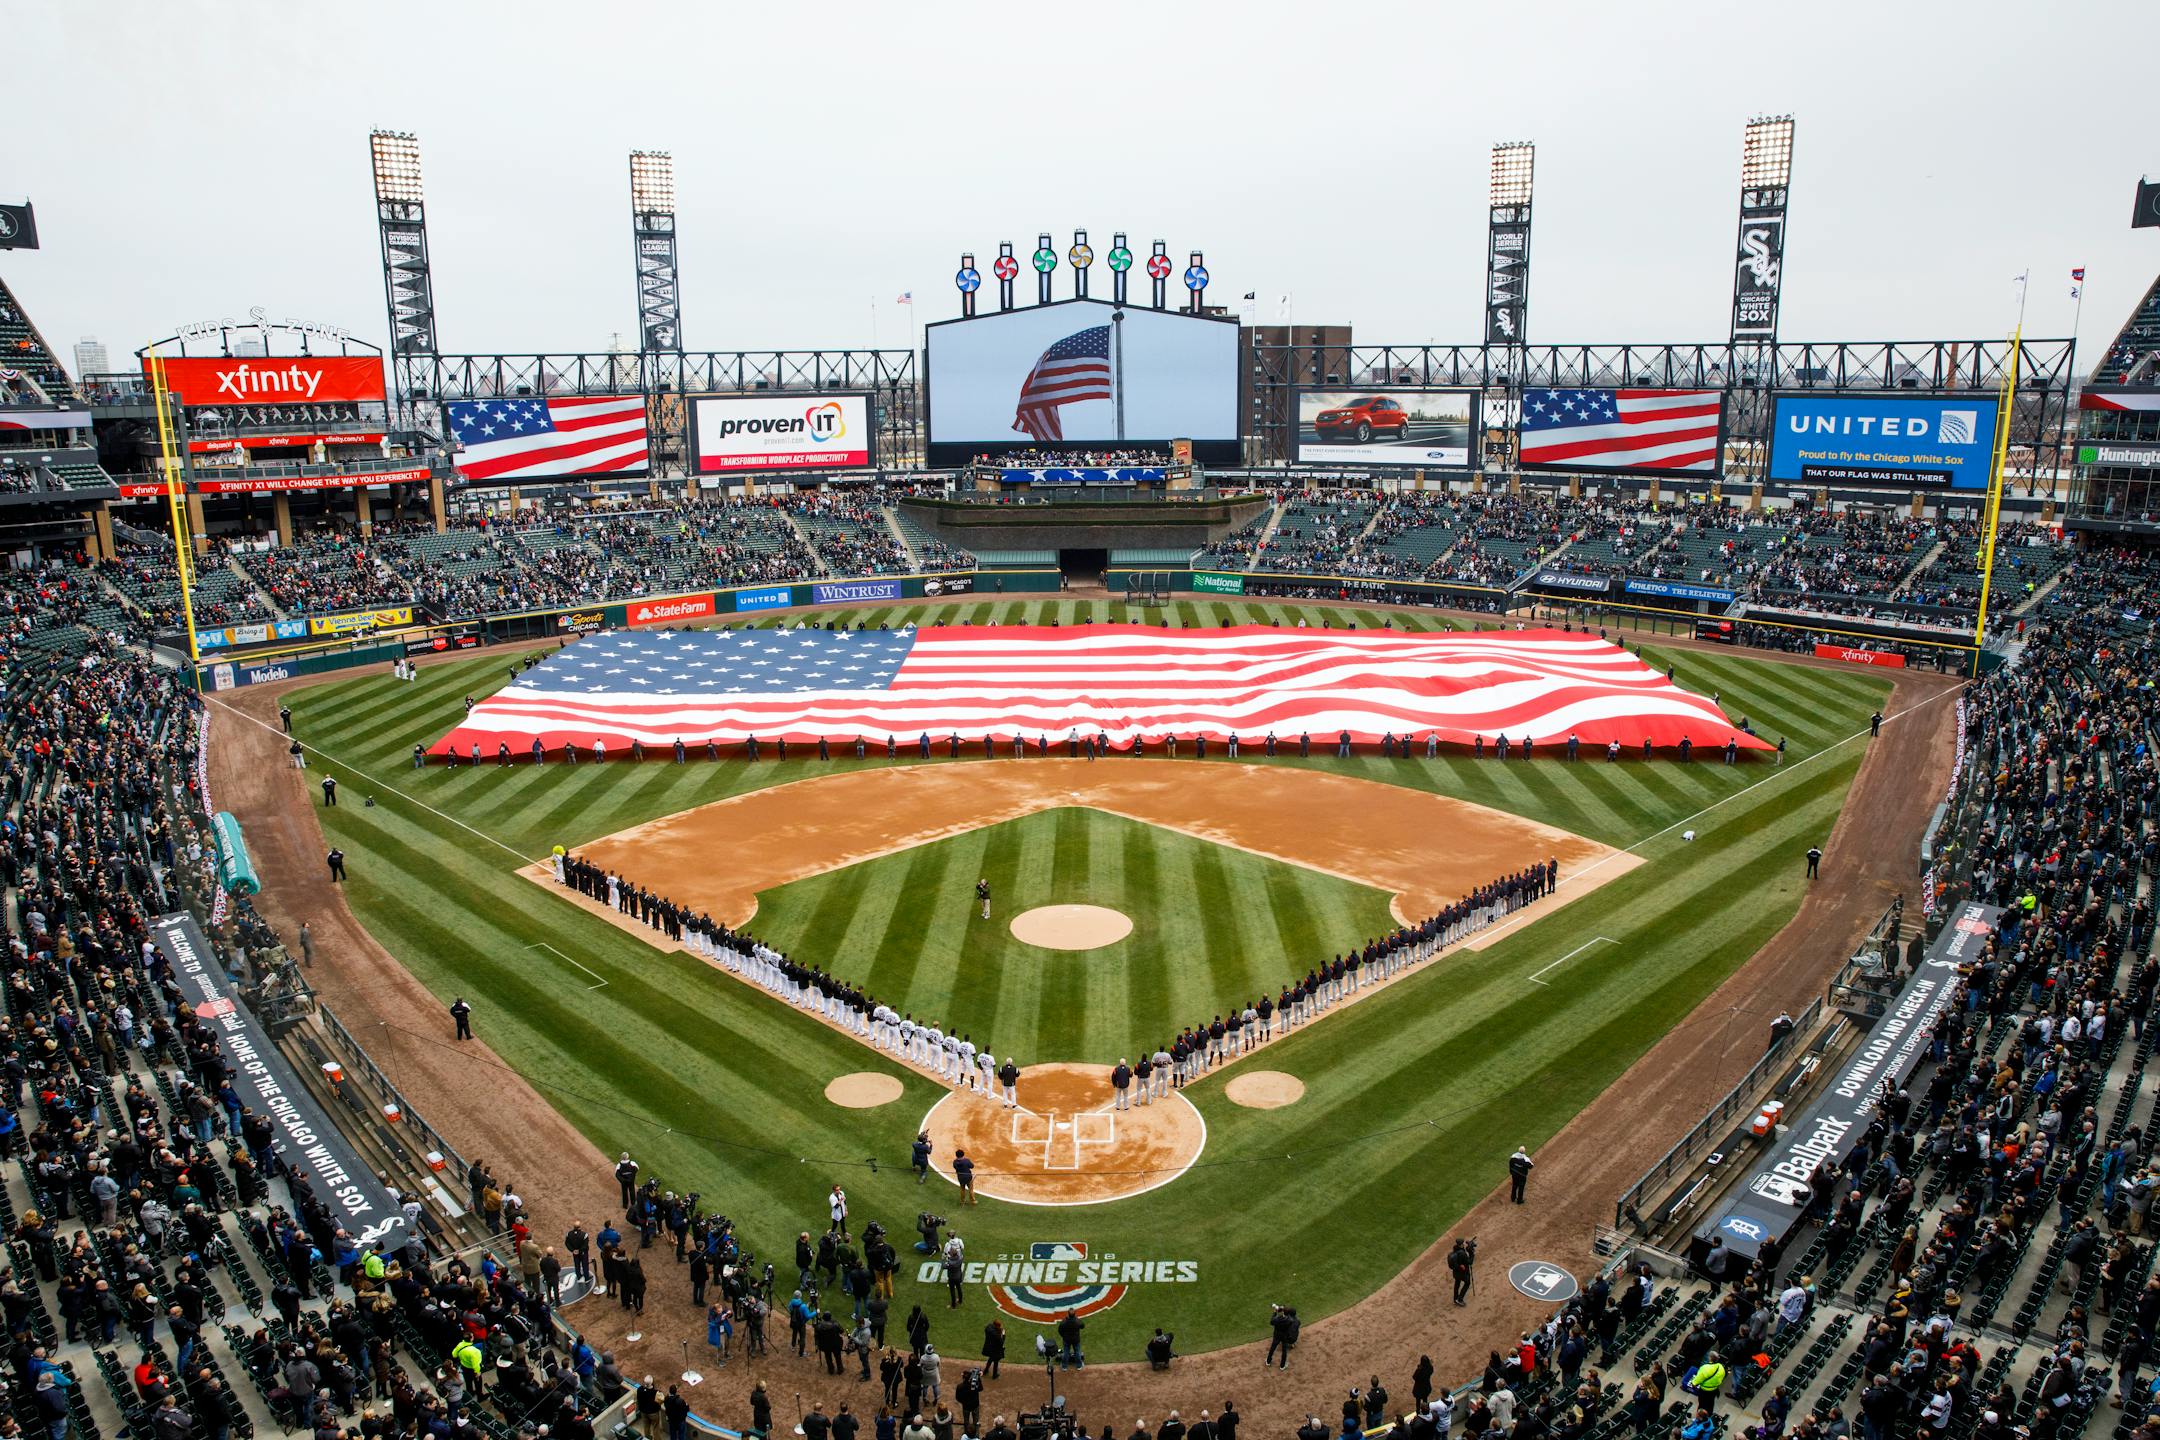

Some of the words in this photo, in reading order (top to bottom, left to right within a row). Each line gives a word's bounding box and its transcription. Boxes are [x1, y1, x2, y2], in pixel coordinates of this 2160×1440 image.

[1739, 310, 1769, 321] SOX
[176, 318, 238, 343] KIDS
[285, 317, 351, 345] ZONE
[216, 364, 323, 399] xfinity
[720, 417, 804, 438] proven
[816, 414, 835, 431] IT
[1790, 415, 1929, 436] UNITED
[268, 437, 290, 446] xfinity
[720, 456, 768, 466] TRANSFORMING
[768, 455, 804, 465] WORKPLACE
[805, 453, 849, 463] PRODUCTIVITY
[1798, 450, 1826, 459] Proud
[1828, 451, 1838, 460] to
[1839, 451, 1852, 462] fly
[1855, 452, 1871, 461] the
[1873, 452, 1910, 464] Chicago
[1913, 454, 1943, 464] White
[1945, 455, 1964, 464] Sox
[219, 482, 253, 490] XFINITY
[255, 481, 265, 489] X1
[267, 480, 288, 489] WILL
[289, 479, 323, 488] CHANGE
[325, 478, 341, 486] THE
[342, 477, 358, 485] WAY
[359, 475, 375, 484] YOU
[375, 473, 413, 483] EXPERIENCE
[1892, 473, 1914, 481] STILL
[1917, 474, 1947, 482] THERE.
[132, 486, 159, 496] xfinity
[1204, 576, 1242, 588] National
[1557, 577, 1604, 588] HYUNDAI
[1628, 581, 1668, 592] ATHLETICO
[1688, 589, 1731, 600] RELIEVERS
[740, 593, 776, 605] UNITED
[819, 583, 894, 600] WINTRUST
[328, 616, 357, 625] Vienna
[358, 613, 375, 621] Beef
[568, 623, 600, 632] CHICAGO
[571, 613, 604, 626] Sports
[407, 641, 434, 651] guaranteed
[1841, 650, 1876, 663] xfinity
[250, 667, 288, 684] Modelo
[166, 928, 198, 963] WELCOME
[183, 960, 202, 973] TO
[219, 1012, 247, 1032] Field
[226, 1033, 257, 1062] HOME
[1834, 1038, 1893, 1098] DOWNLOAD
[1880, 1018, 1908, 1041] AND
[1853, 1097, 1877, 1117] MAPS
[1929, 1000, 1944, 1018] SEAT
[244, 1061, 267, 1076] OF
[253, 1074, 283, 1099] THE
[267, 1096, 318, 1146] CHICAGO
[1773, 1115, 1853, 1181] Ballpark
[305, 1144, 350, 1187] WHITE
[335, 1185, 373, 1217] SOX
[1077, 1261, 1198, 1283] SERIES
